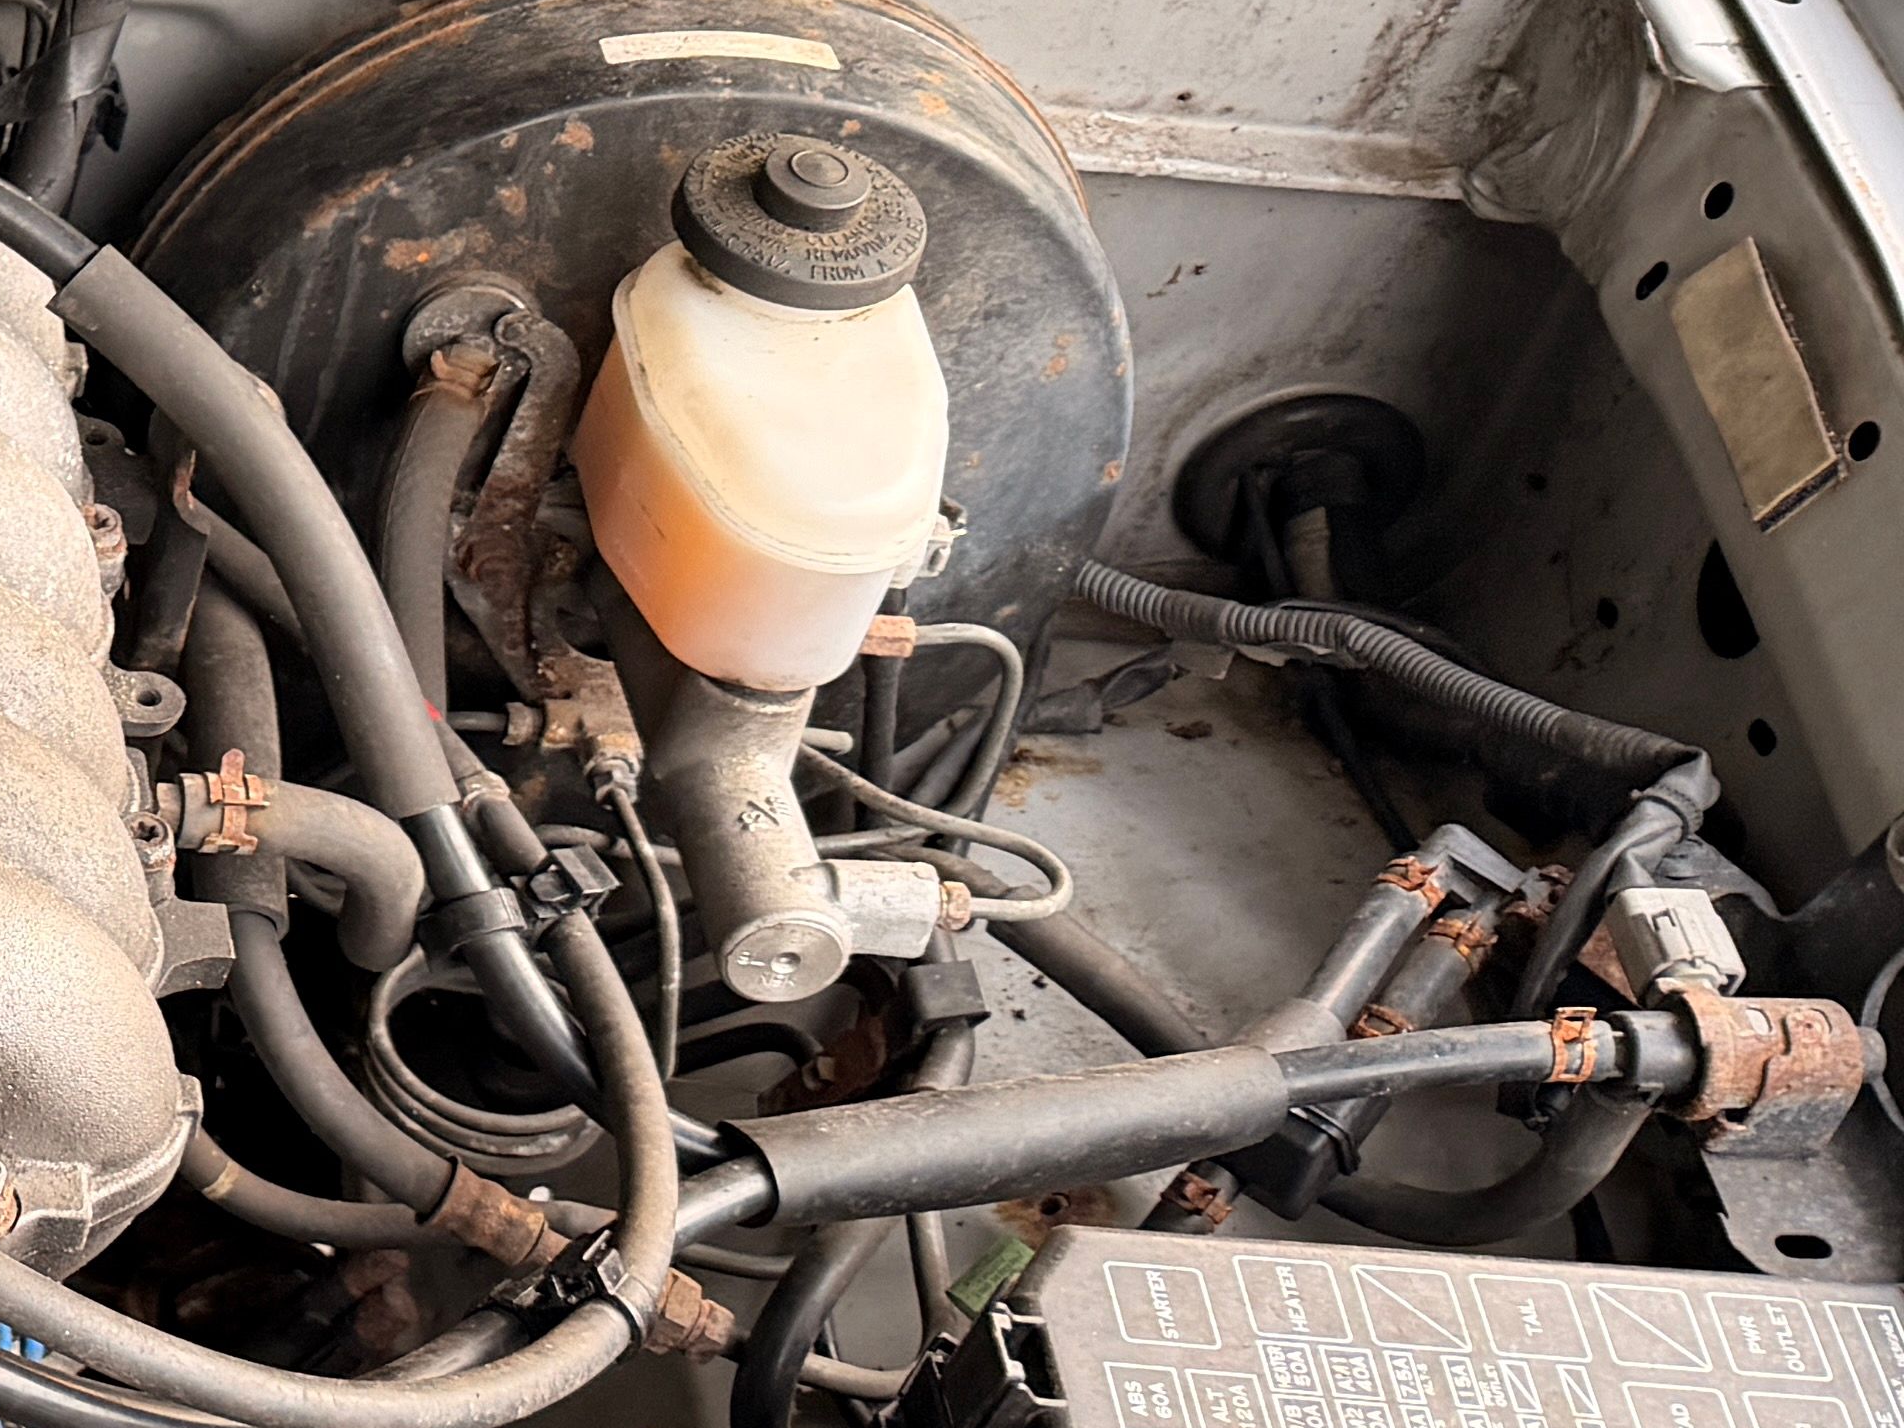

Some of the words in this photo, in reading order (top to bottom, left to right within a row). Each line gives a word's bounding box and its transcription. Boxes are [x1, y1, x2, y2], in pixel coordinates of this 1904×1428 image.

[809, 264, 866, 282] FROM
[1145, 1270, 1180, 1340] STARTER
[1275, 1265, 1310, 1333] HEATER
[1516, 1298, 1544, 1337] TAIL
[1738, 1315, 1768, 1355] PWR
[1765, 1303, 1807, 1373] OUTLET
[1266, 1345, 1292, 1388] HEATER
[1289, 1350, 1312, 1388] 50A
[1330, 1356, 1356, 1392] AM1
[1347, 1356, 1374, 1393] 40A
[1392, 1357, 1418, 1399] 7.5A
[1454, 1363, 1475, 1398] 15A
[1483, 1363, 1509, 1408] OUTLET
[1124, 1380, 1150, 1417] ABS
[1148, 1382, 1173, 1419] 60A
[1206, 1387, 1232, 1423] ALT
[1228, 1385, 1257, 1428] 120A
